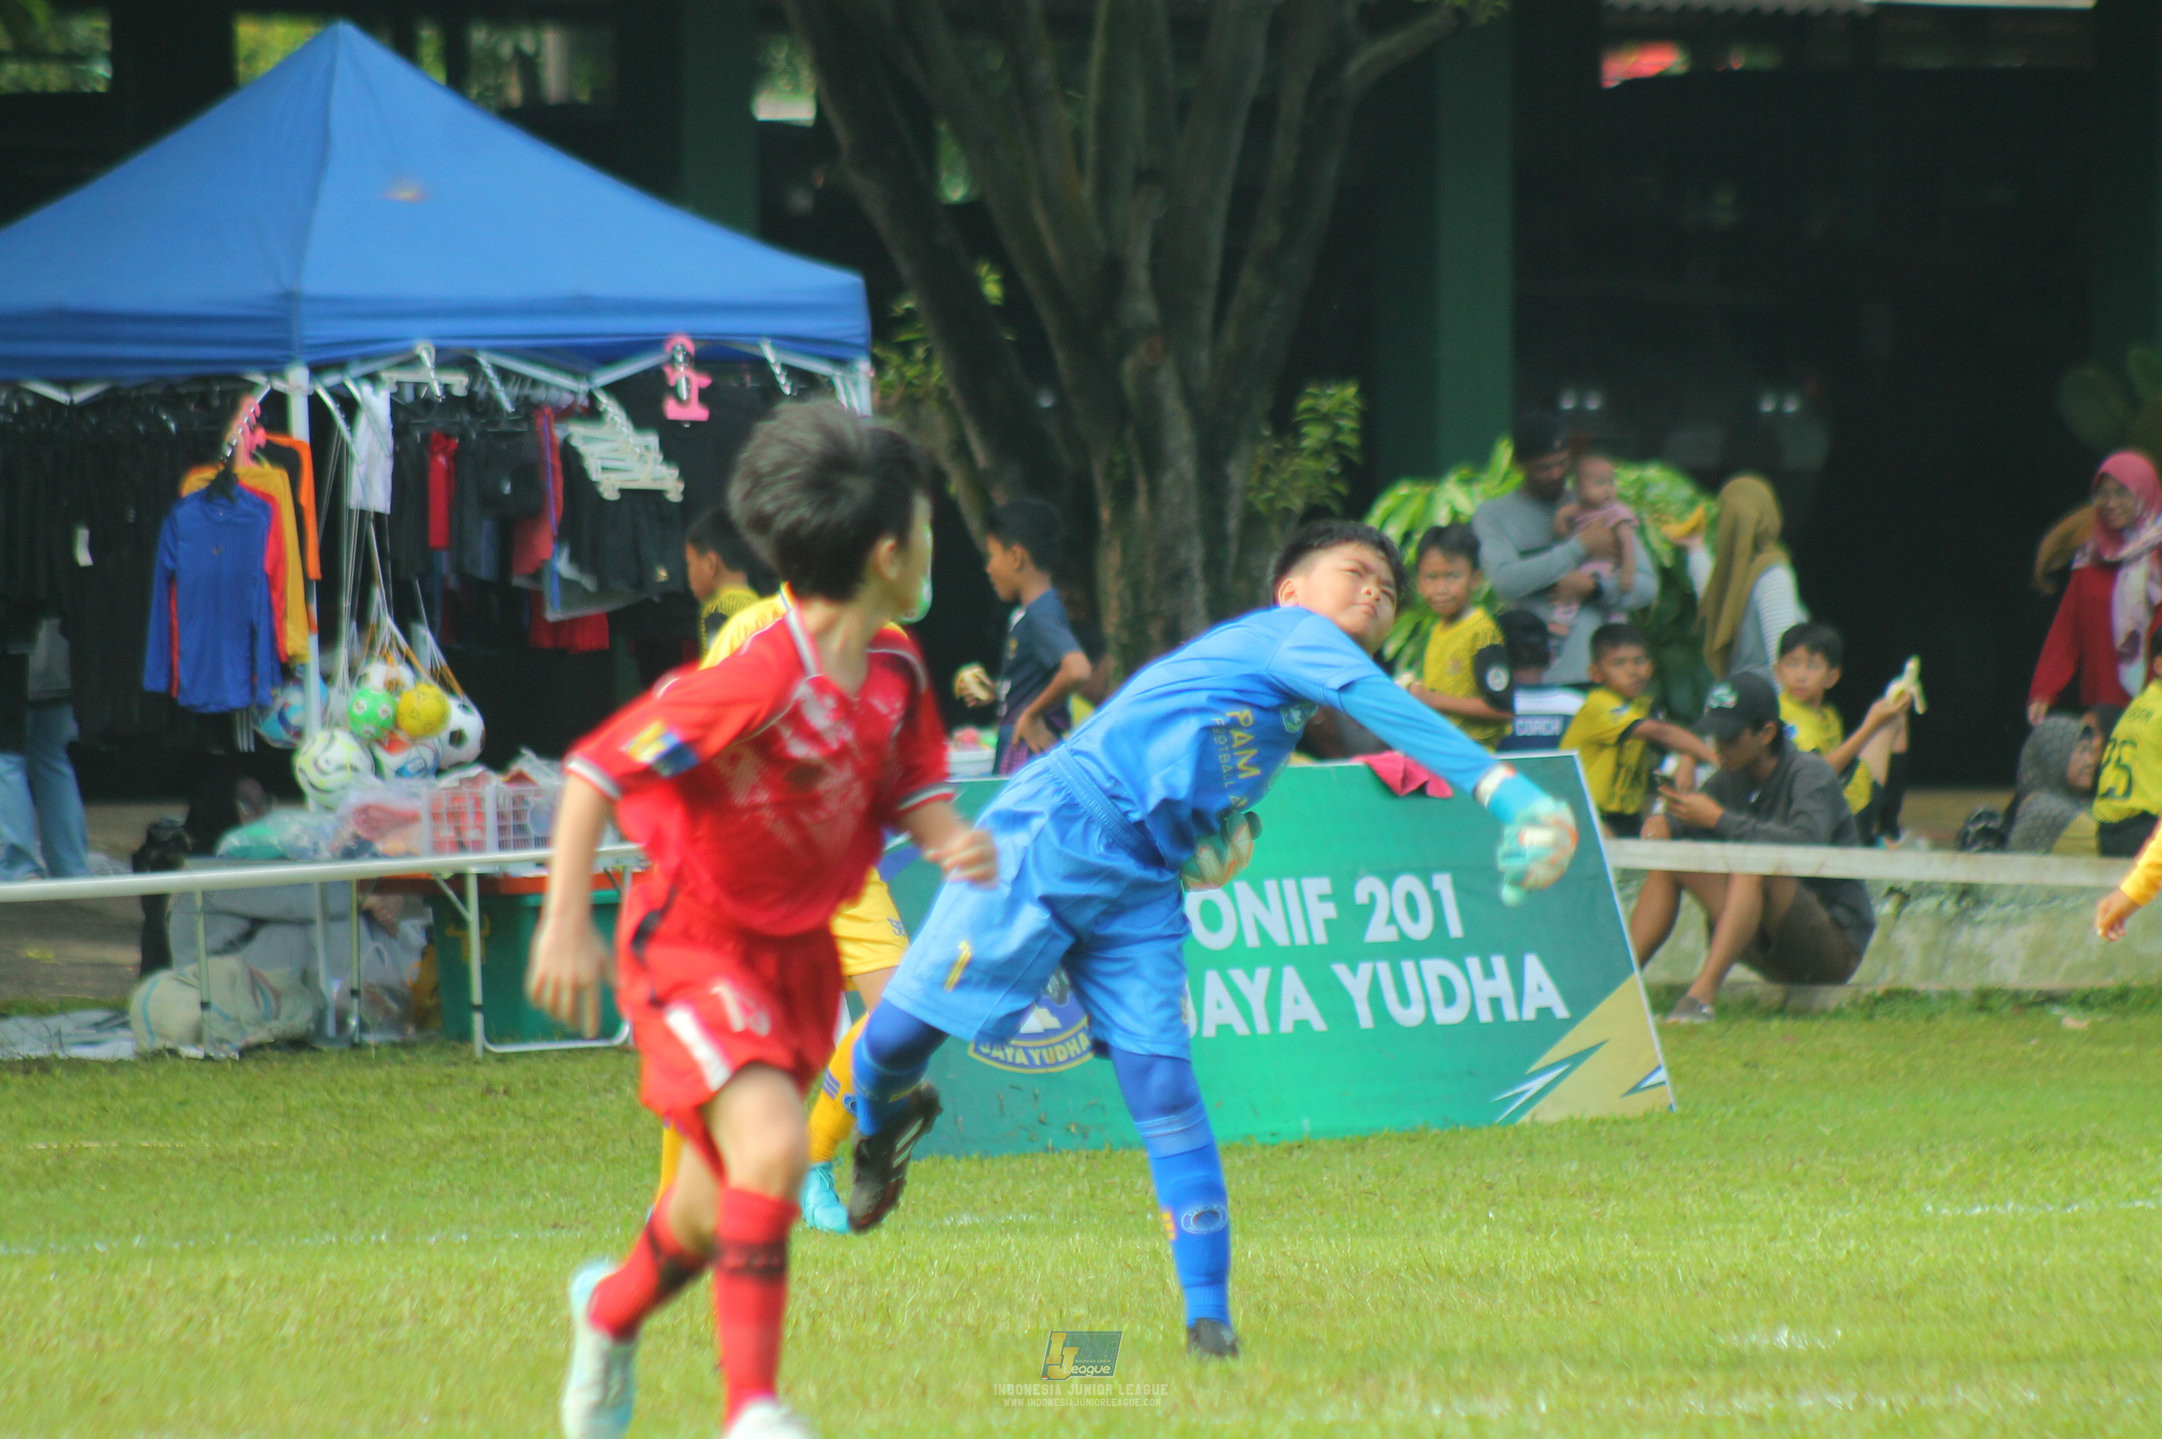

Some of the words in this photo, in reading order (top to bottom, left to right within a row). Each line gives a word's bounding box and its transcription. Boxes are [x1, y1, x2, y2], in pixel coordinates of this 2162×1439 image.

[1226, 709, 1261, 779] PAM
[1354, 872, 1464, 943] 201
[1330, 953, 1571, 1029] YUDHA
[1028, 1032, 1091, 1066] YUDHA
